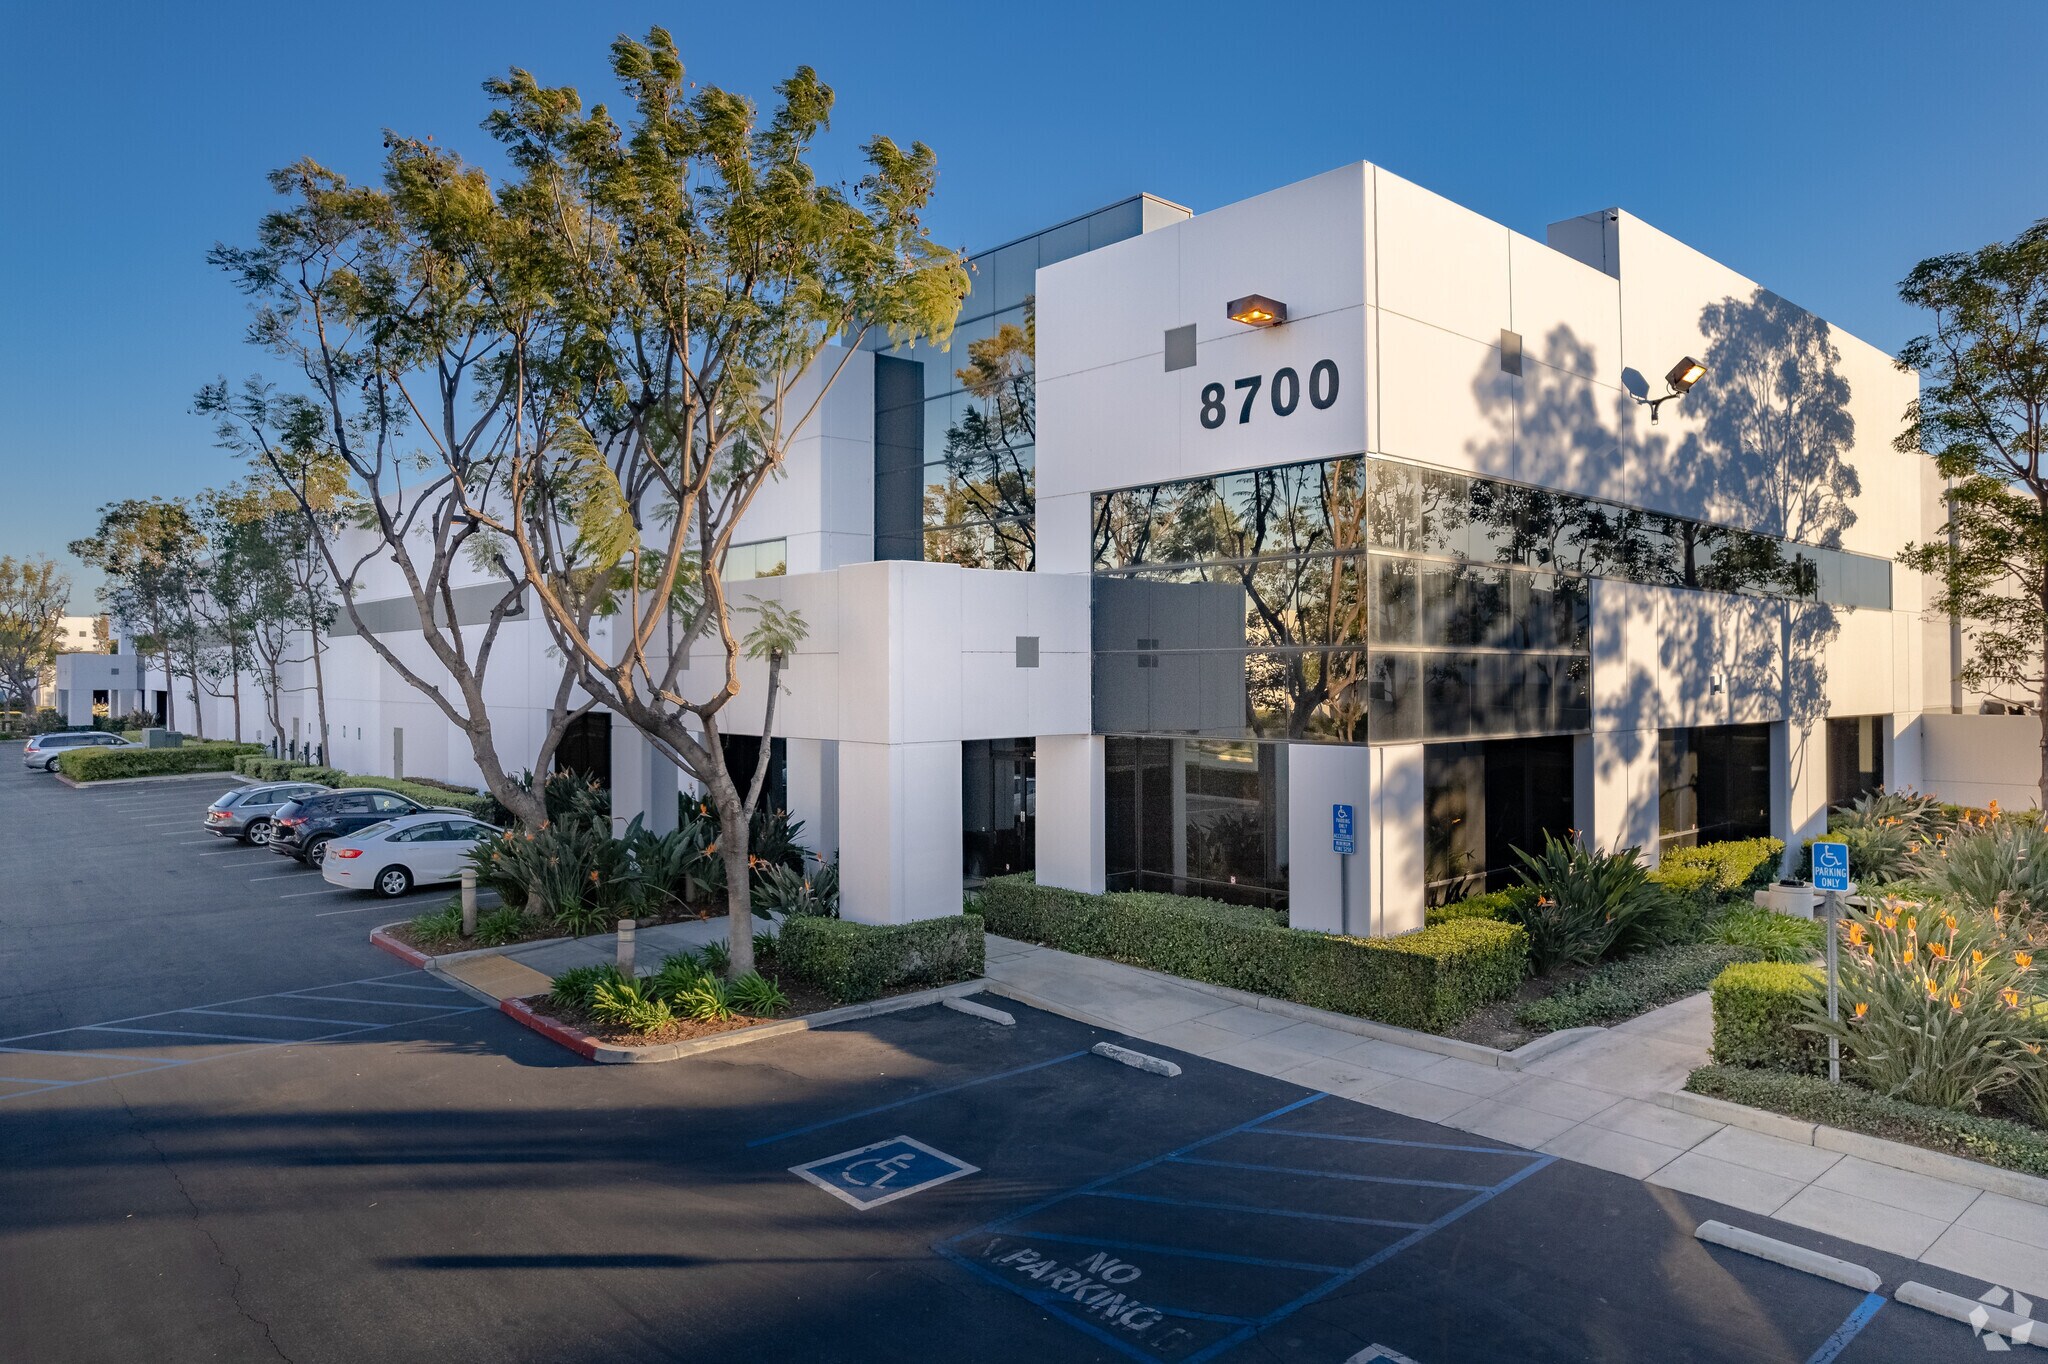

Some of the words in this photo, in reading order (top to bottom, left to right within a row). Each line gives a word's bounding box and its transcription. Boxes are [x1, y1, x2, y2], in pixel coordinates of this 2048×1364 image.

[1200, 358, 1340, 430] 8700
[1815, 866, 1847, 878] PARKING
[1821, 877, 1840, 888] ONLY
[1076, 1251, 1142, 1284] NO
[1000, 1247, 1163, 1331] PARKING
